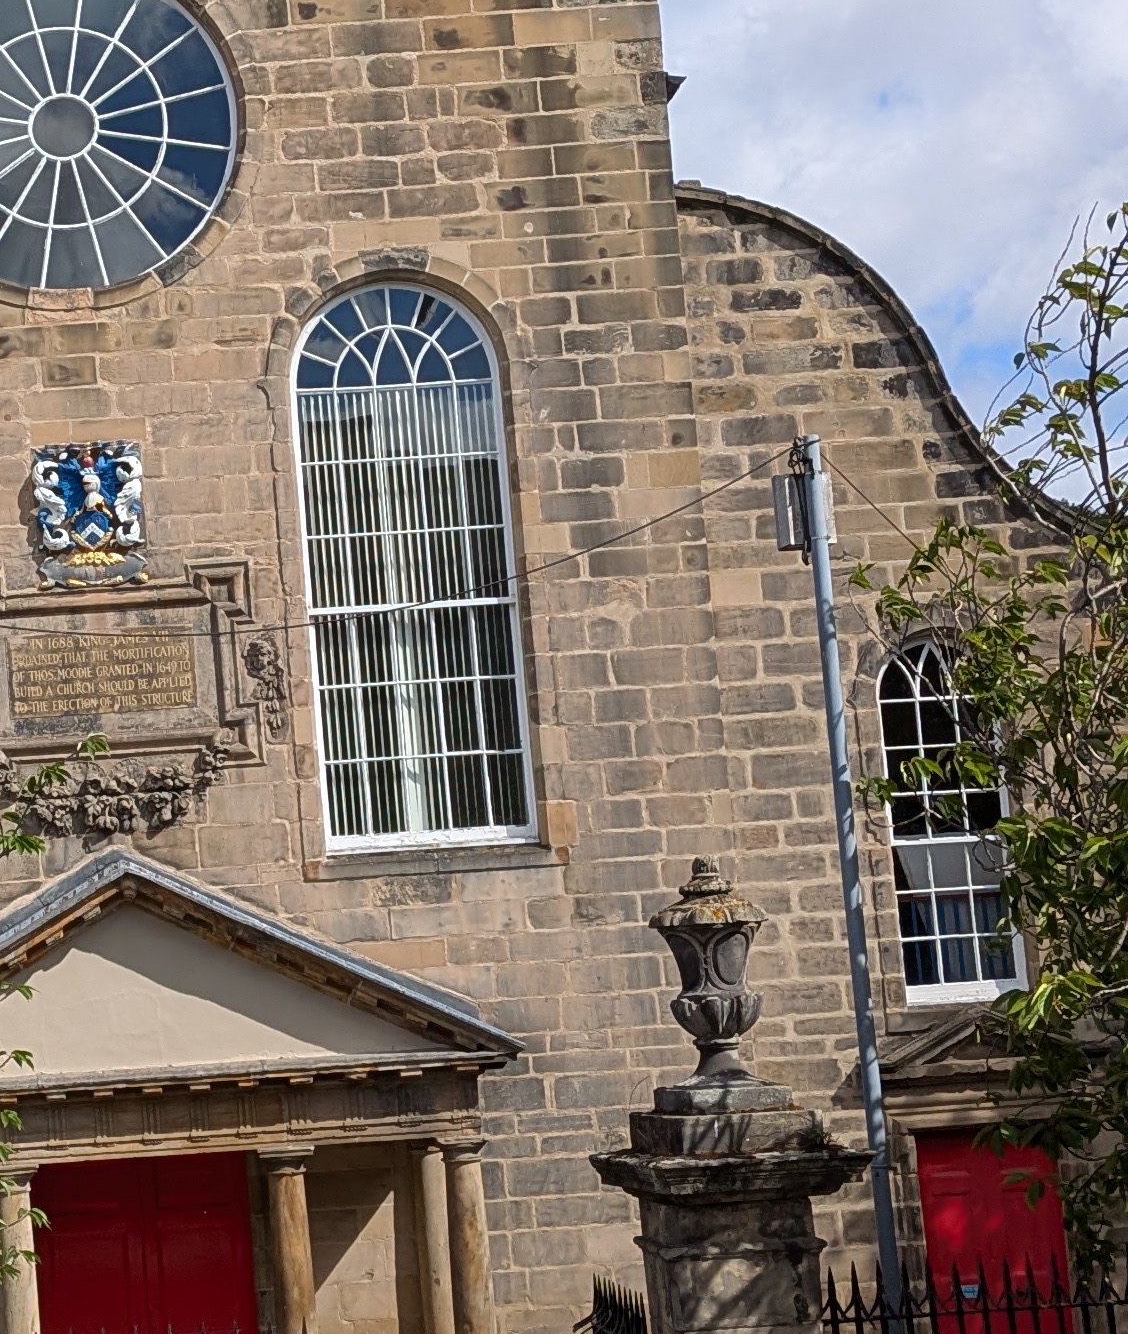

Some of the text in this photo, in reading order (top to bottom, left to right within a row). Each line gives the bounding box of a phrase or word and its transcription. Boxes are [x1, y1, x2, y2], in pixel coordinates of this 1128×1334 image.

[31, 630, 170, 650] IN 1688 KING JAMES VII
[63, 650, 87, 664] THAT
[91, 649, 109, 663] THE
[112, 643, 190, 661] MORTIFICATION
[12, 671, 25, 683] OF
[57, 666, 93, 681] MOODIE
[95, 663, 139, 678] GRANTED
[142, 662, 153, 674] IN
[155, 660, 177, 675] 1649
[177, 659, 191, 673] TO
[45, 685, 54, 698] A
[56, 681, 95, 696] CHURCH
[98, 678, 135, 693] SHOULD
[137, 677, 149, 690] BE
[151, 675, 193, 689] APPLIED
[14, 690, 194, 714] TO THE ERECTION OF THIS STRUCTURE
